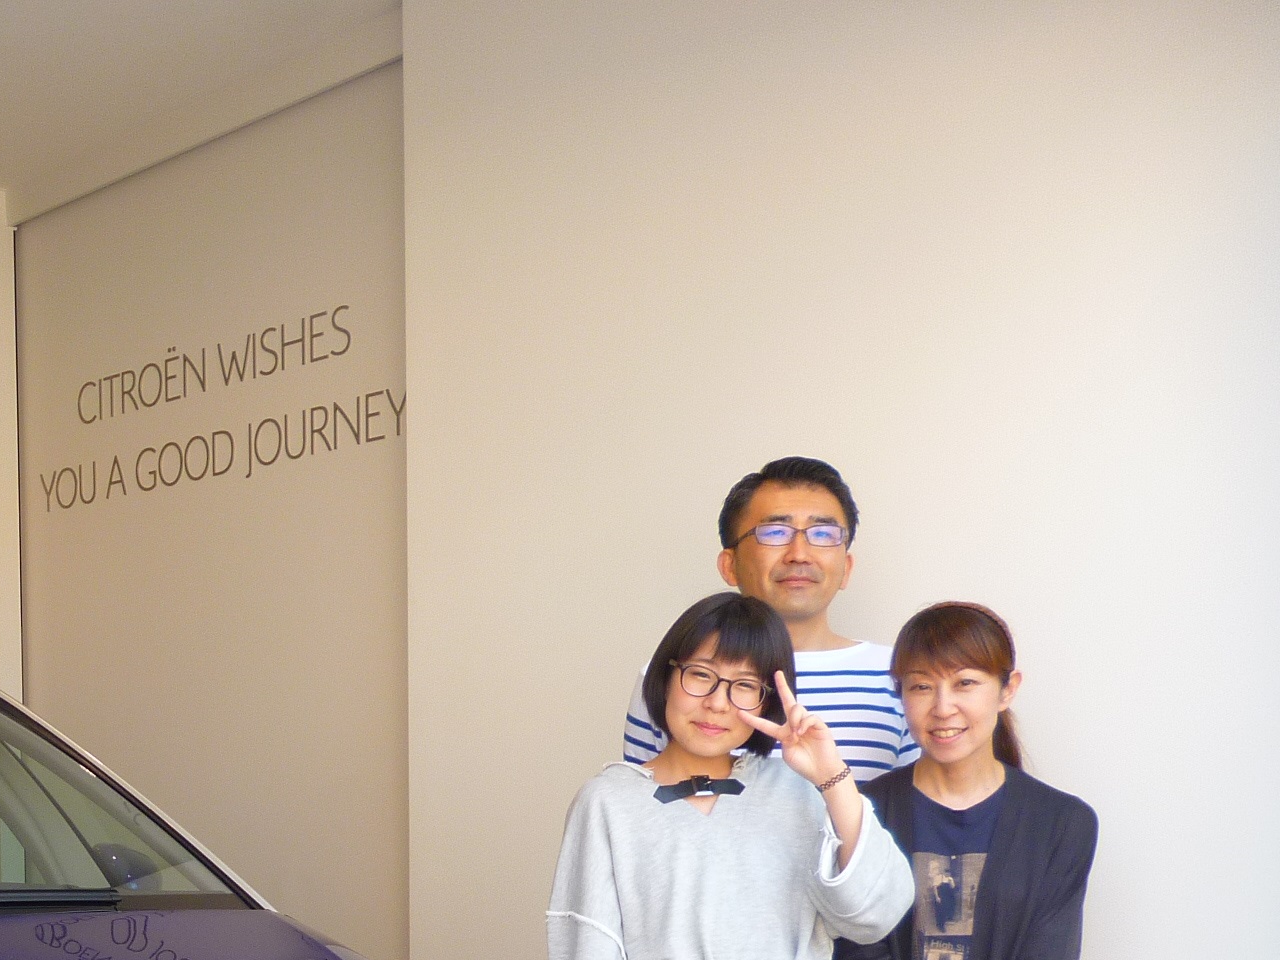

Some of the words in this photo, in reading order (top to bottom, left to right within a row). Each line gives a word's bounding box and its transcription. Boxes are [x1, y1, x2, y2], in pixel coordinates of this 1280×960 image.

[77, 346, 207, 425] CITROËN
[217, 304, 352, 387] WISHES
[39, 460, 97, 513] YOU
[105, 454, 128, 500] A
[135, 429, 235, 492] GOOD
[245, 388, 407, 479] JOURNEY
